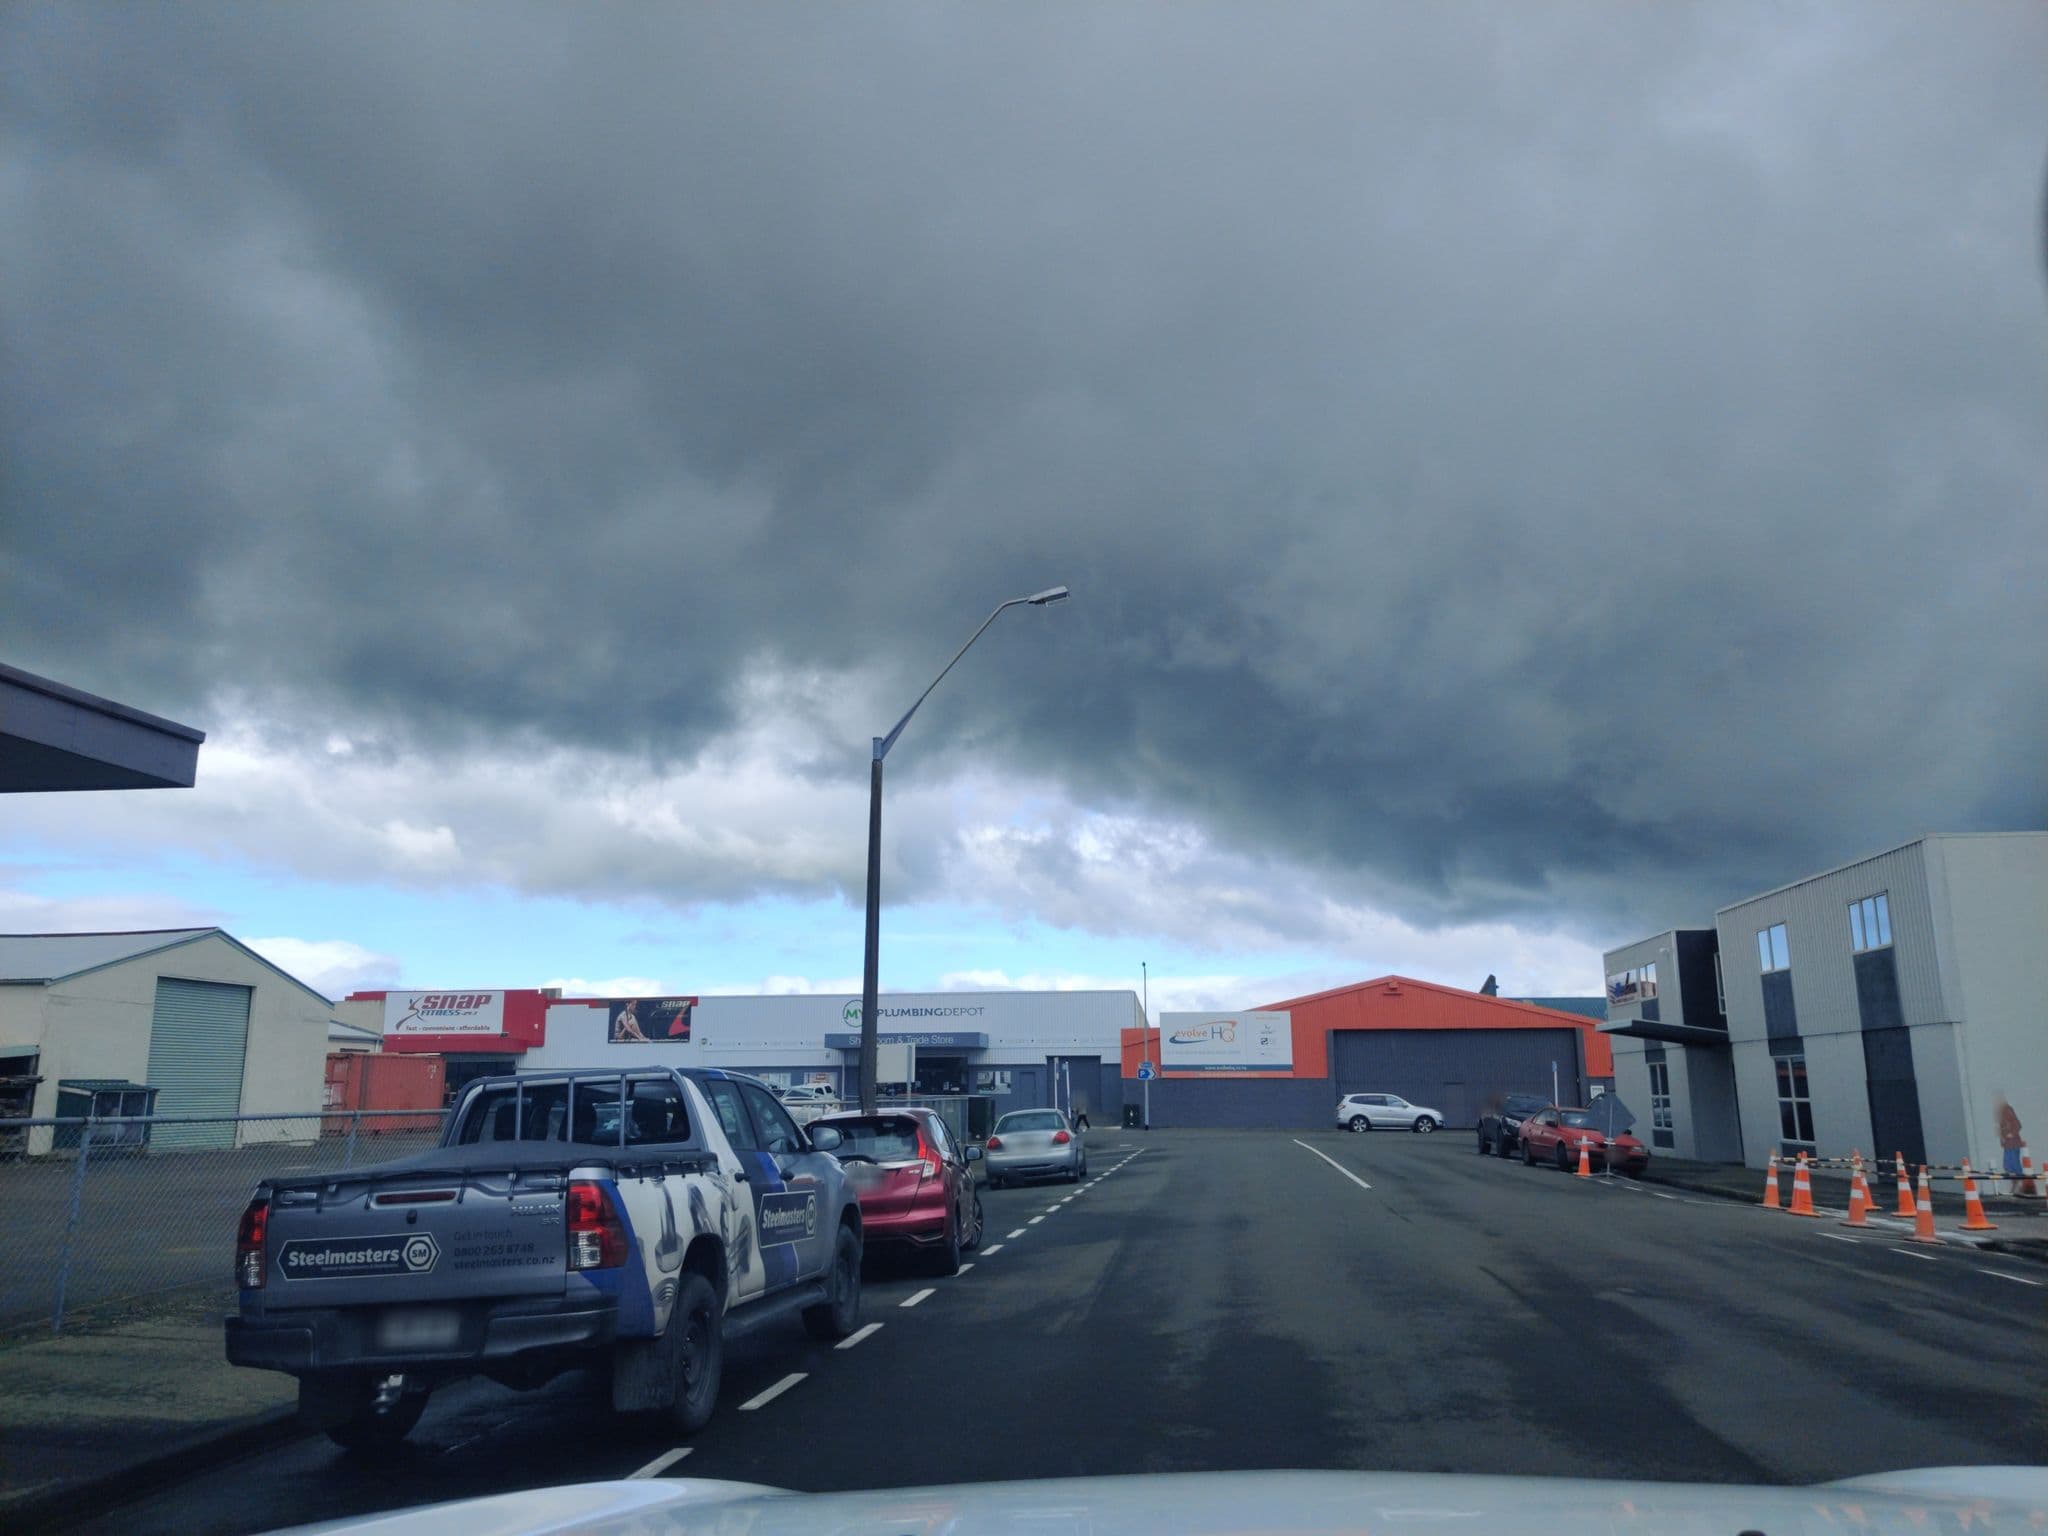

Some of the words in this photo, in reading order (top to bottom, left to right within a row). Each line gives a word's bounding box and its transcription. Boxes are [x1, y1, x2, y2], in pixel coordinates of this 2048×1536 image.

[930, 1034, 954, 1045] Store
[1175, 1027, 1208, 1038] evolve
[1211, 1025, 1235, 1043] HQ
[762, 1208, 805, 1228] Steelmasters
[288, 1249, 400, 1267] Steelmasters
[411, 1249, 427, 1258] SM
